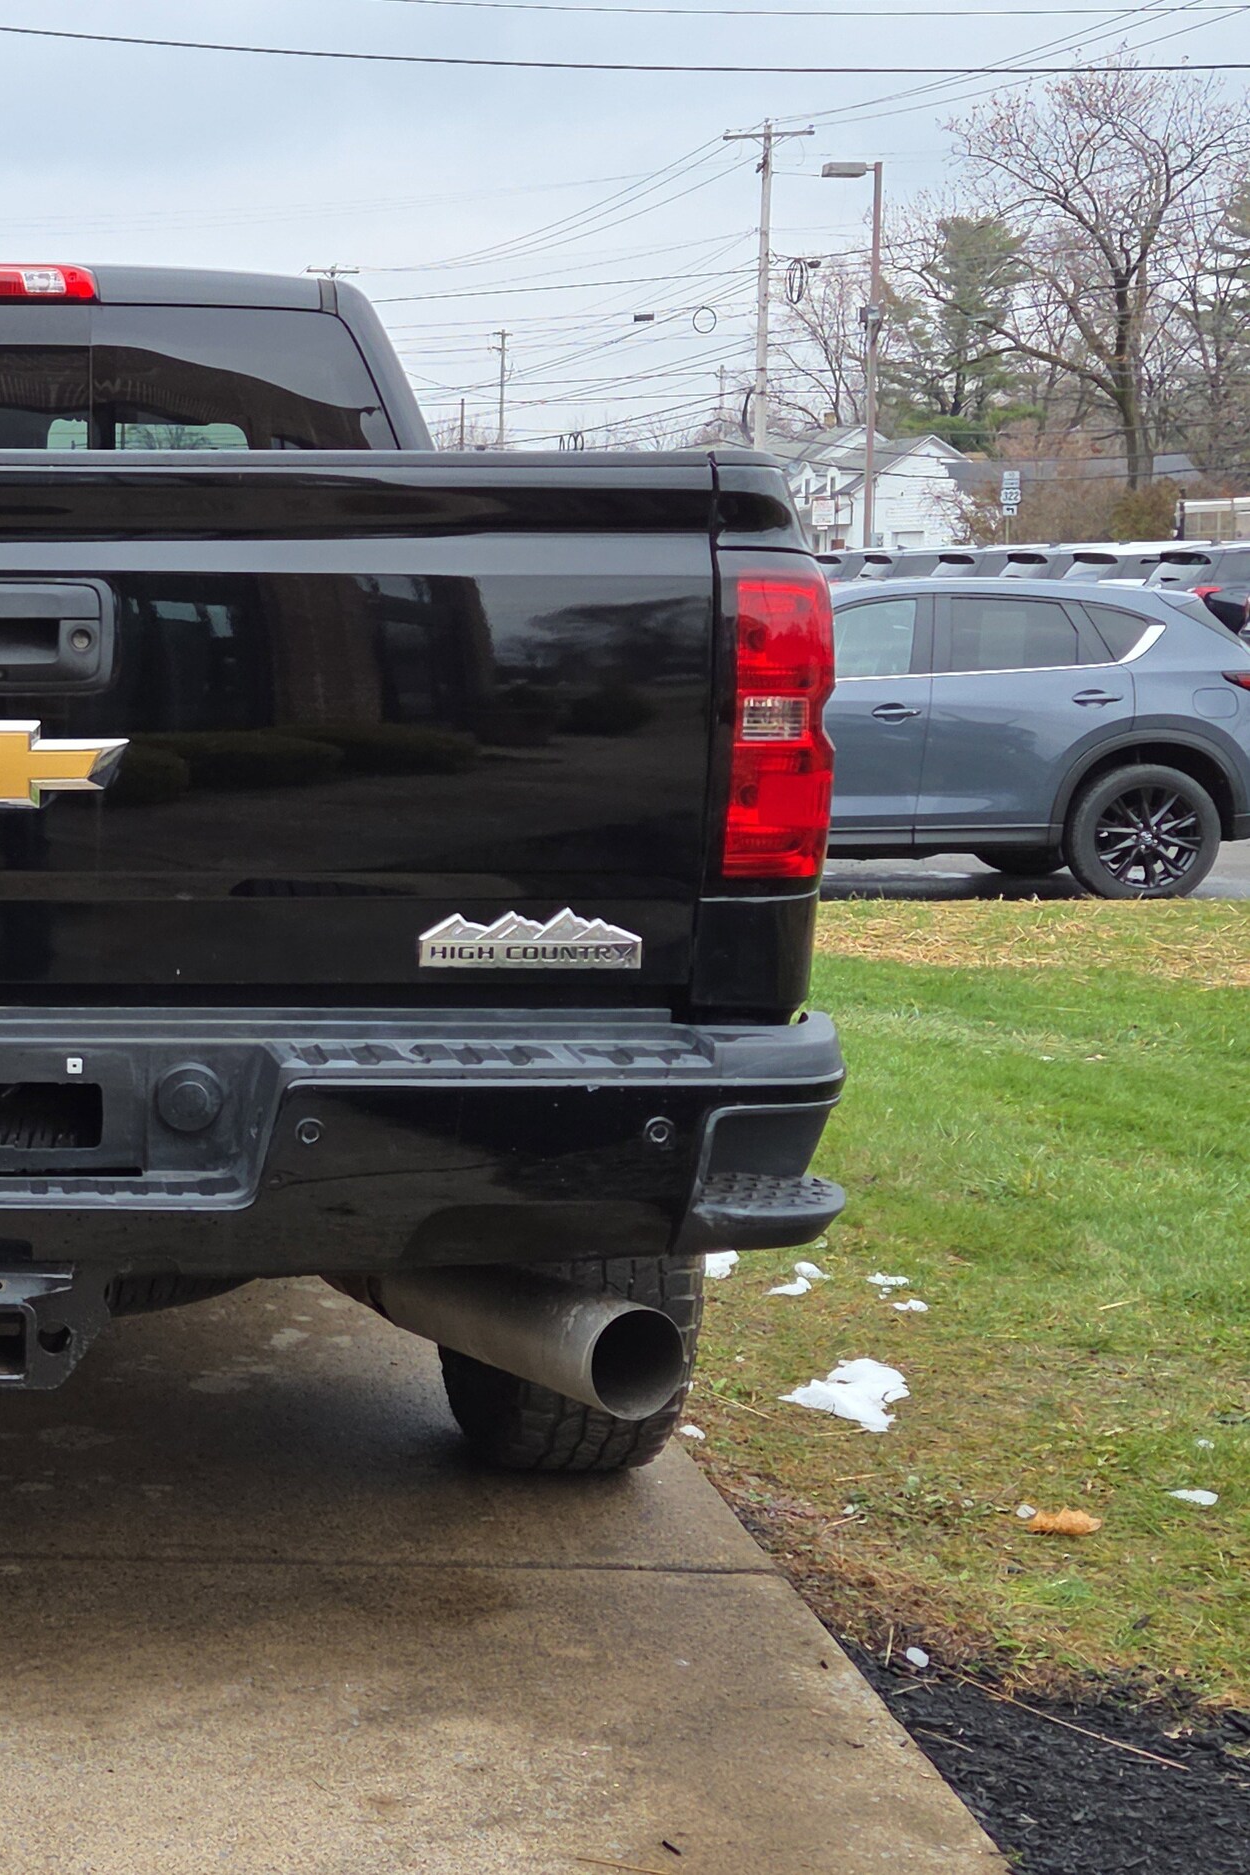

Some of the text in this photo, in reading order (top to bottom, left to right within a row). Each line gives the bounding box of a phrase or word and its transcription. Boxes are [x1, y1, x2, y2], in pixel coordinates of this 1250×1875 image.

[1002, 491, 1019, 501] 322
[430, 945, 632, 962] HIGH COUNTRY
